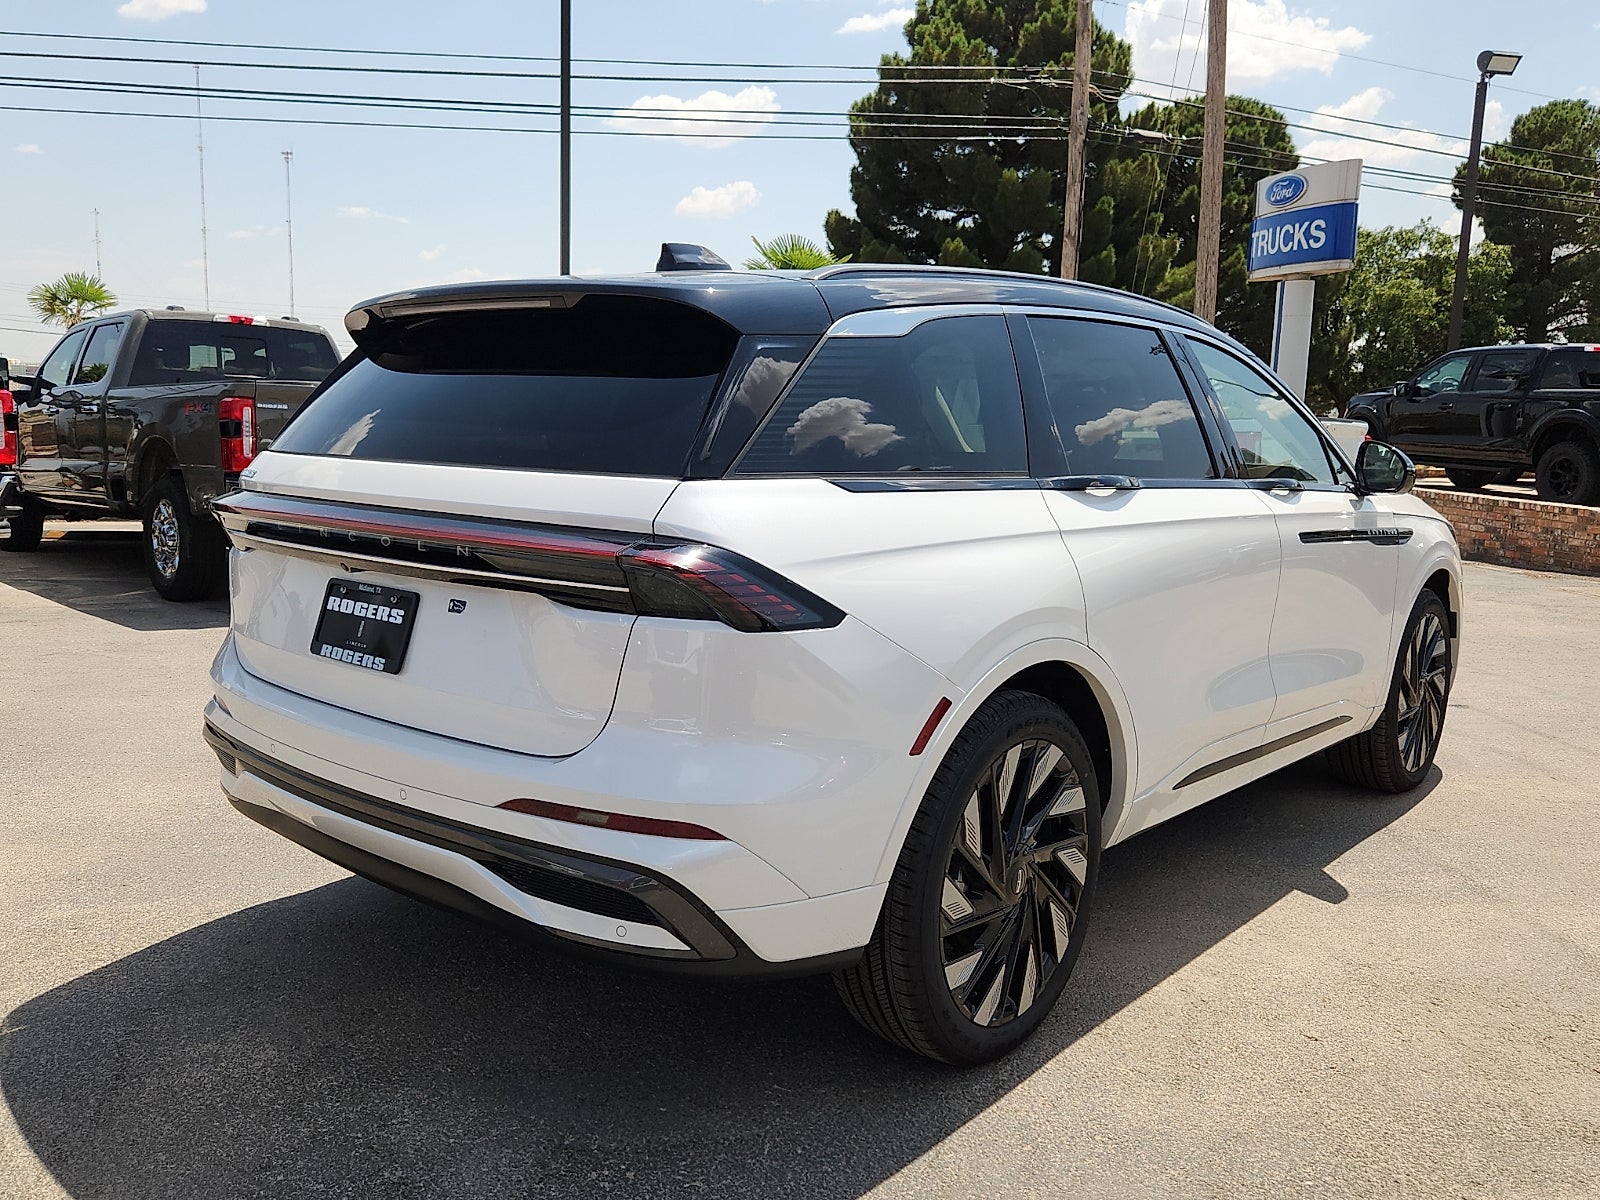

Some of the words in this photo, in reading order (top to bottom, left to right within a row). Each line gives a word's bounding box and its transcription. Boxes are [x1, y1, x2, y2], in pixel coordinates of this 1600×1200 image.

[1270, 181, 1295, 202] Ford
[1252, 219, 1326, 258] TRUCKS
[184, 402, 212, 416] FX4
[277, 523, 471, 557] LINCOLN
[326, 595, 405, 625] ROGERS
[320, 643, 386, 672] ROGERS
[346, 640, 367, 649] LINCOLN
